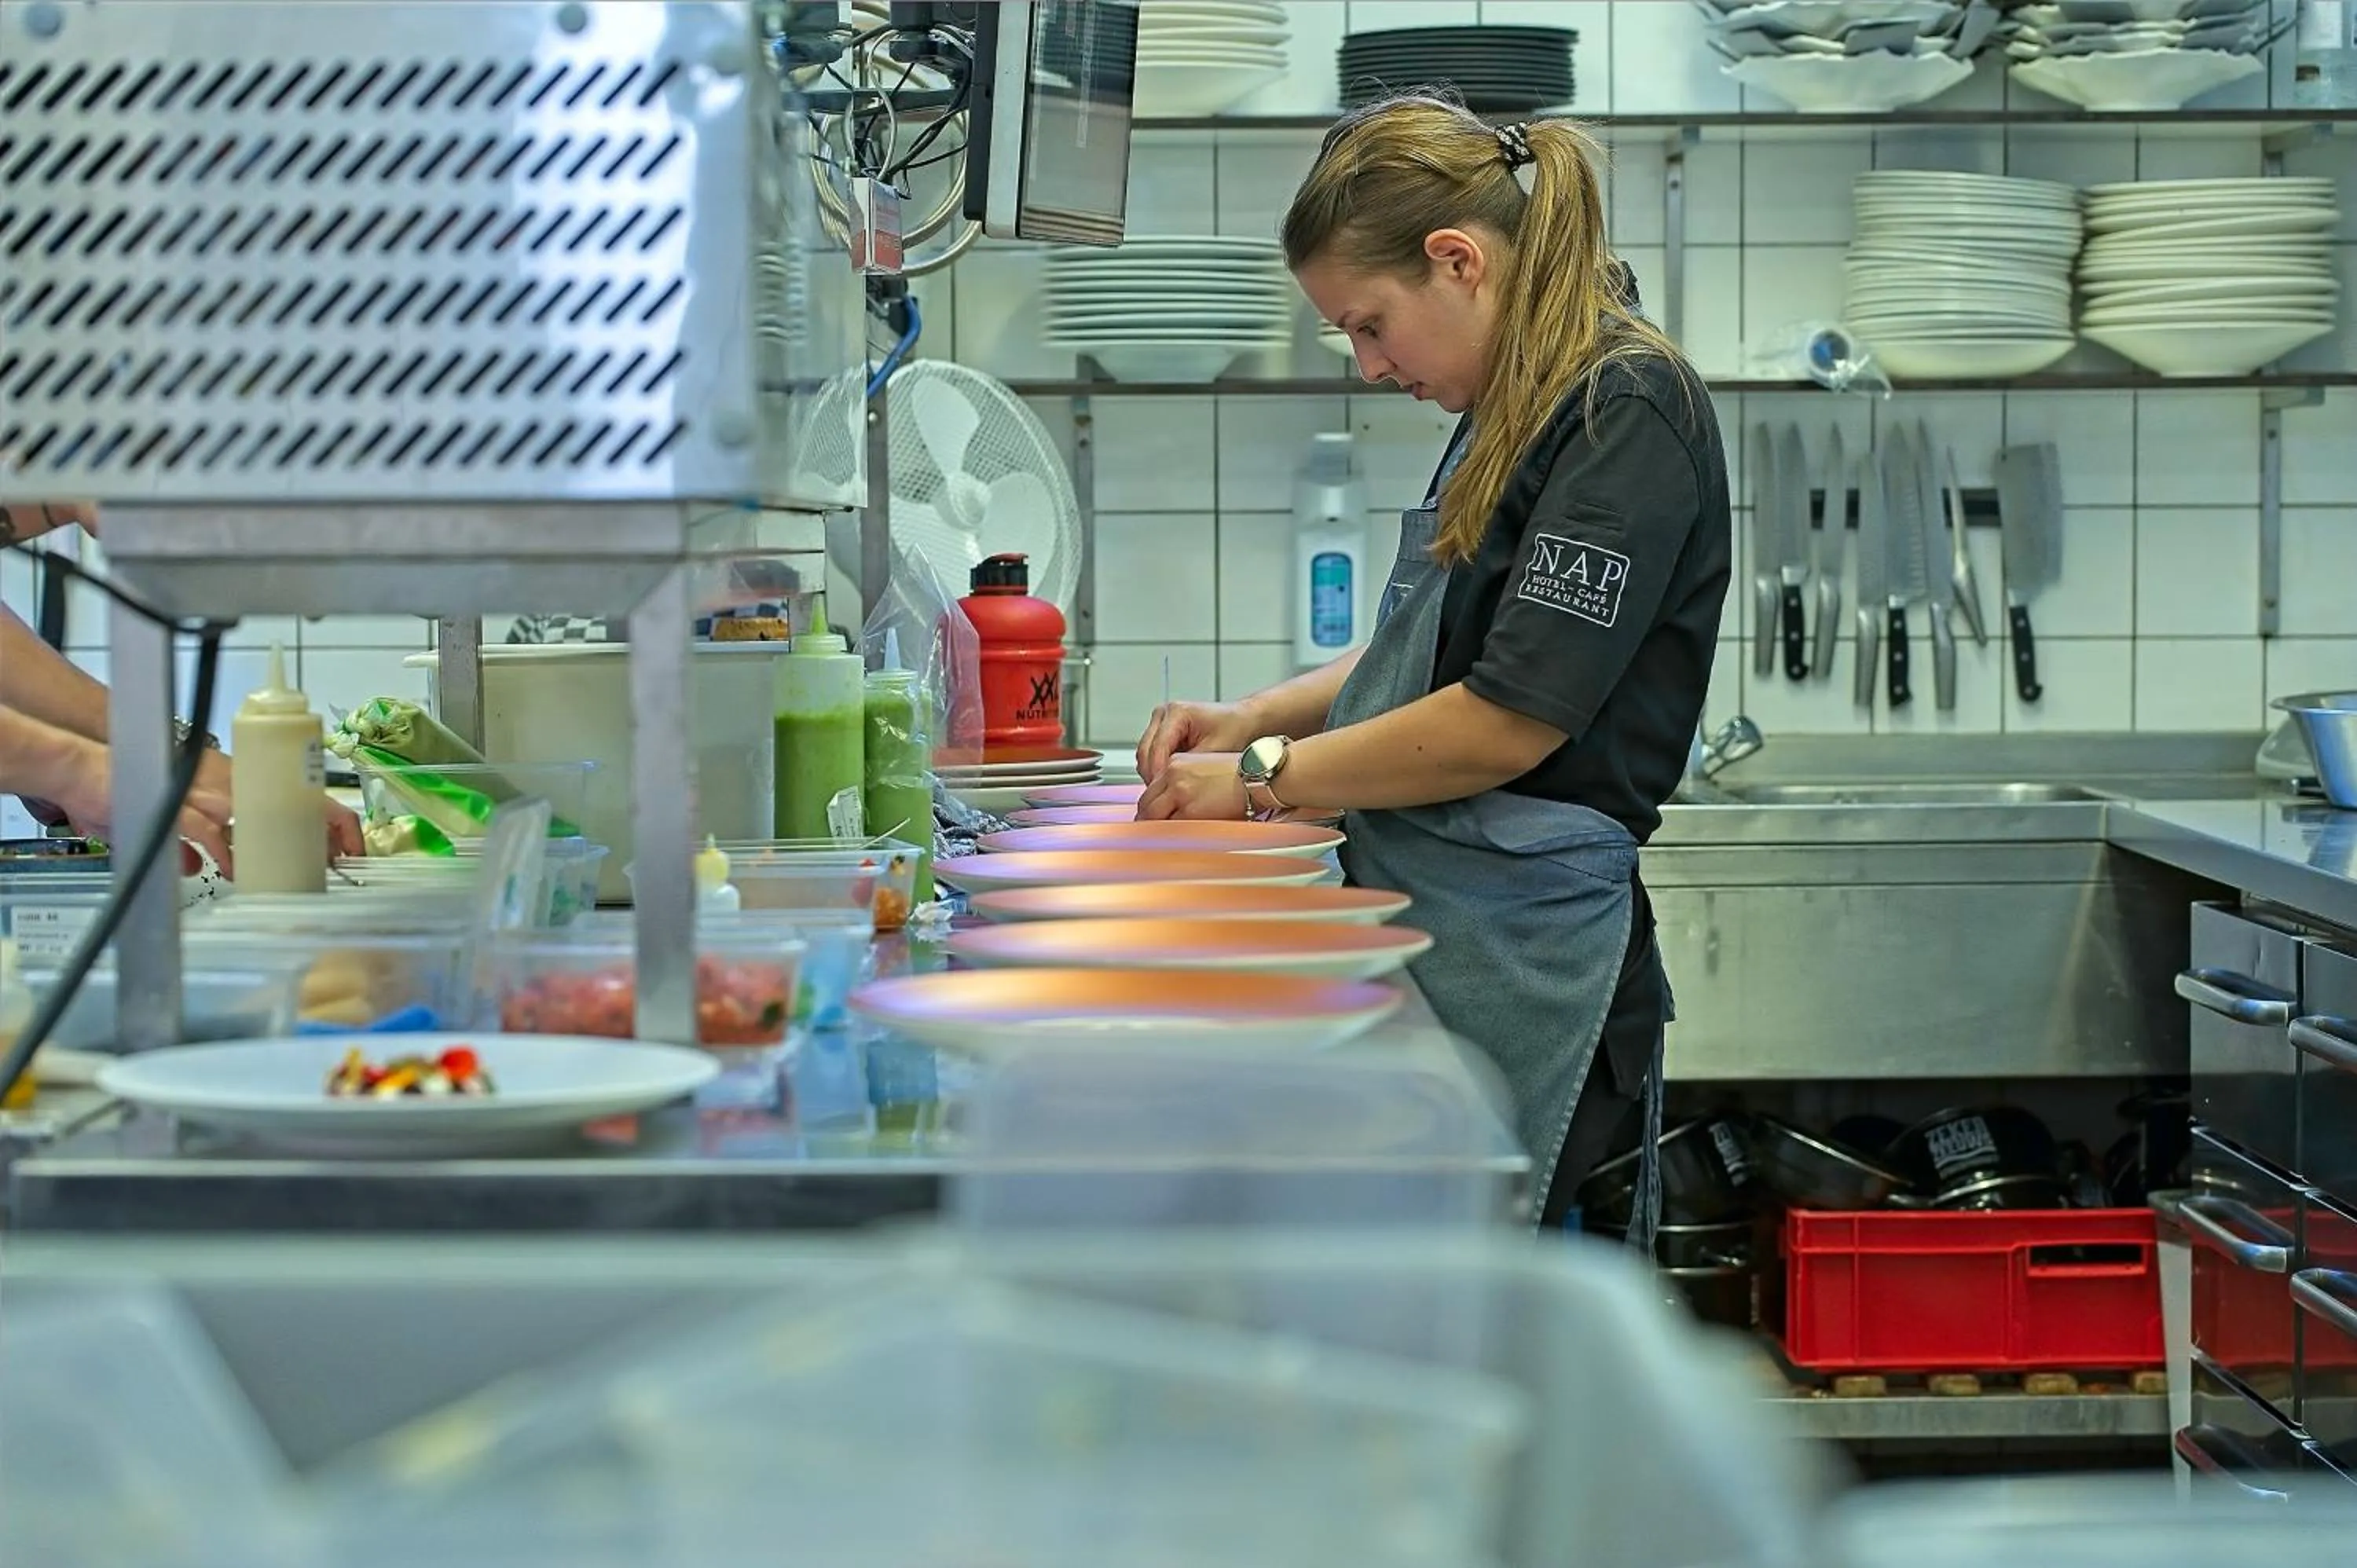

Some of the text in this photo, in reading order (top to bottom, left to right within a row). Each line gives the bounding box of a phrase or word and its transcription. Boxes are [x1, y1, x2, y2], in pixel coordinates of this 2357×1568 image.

[1532, 541, 1622, 592] NAP
[1532, 574, 1566, 592] HOTEL
[1526, 584, 1611, 617] RESTAURANT
